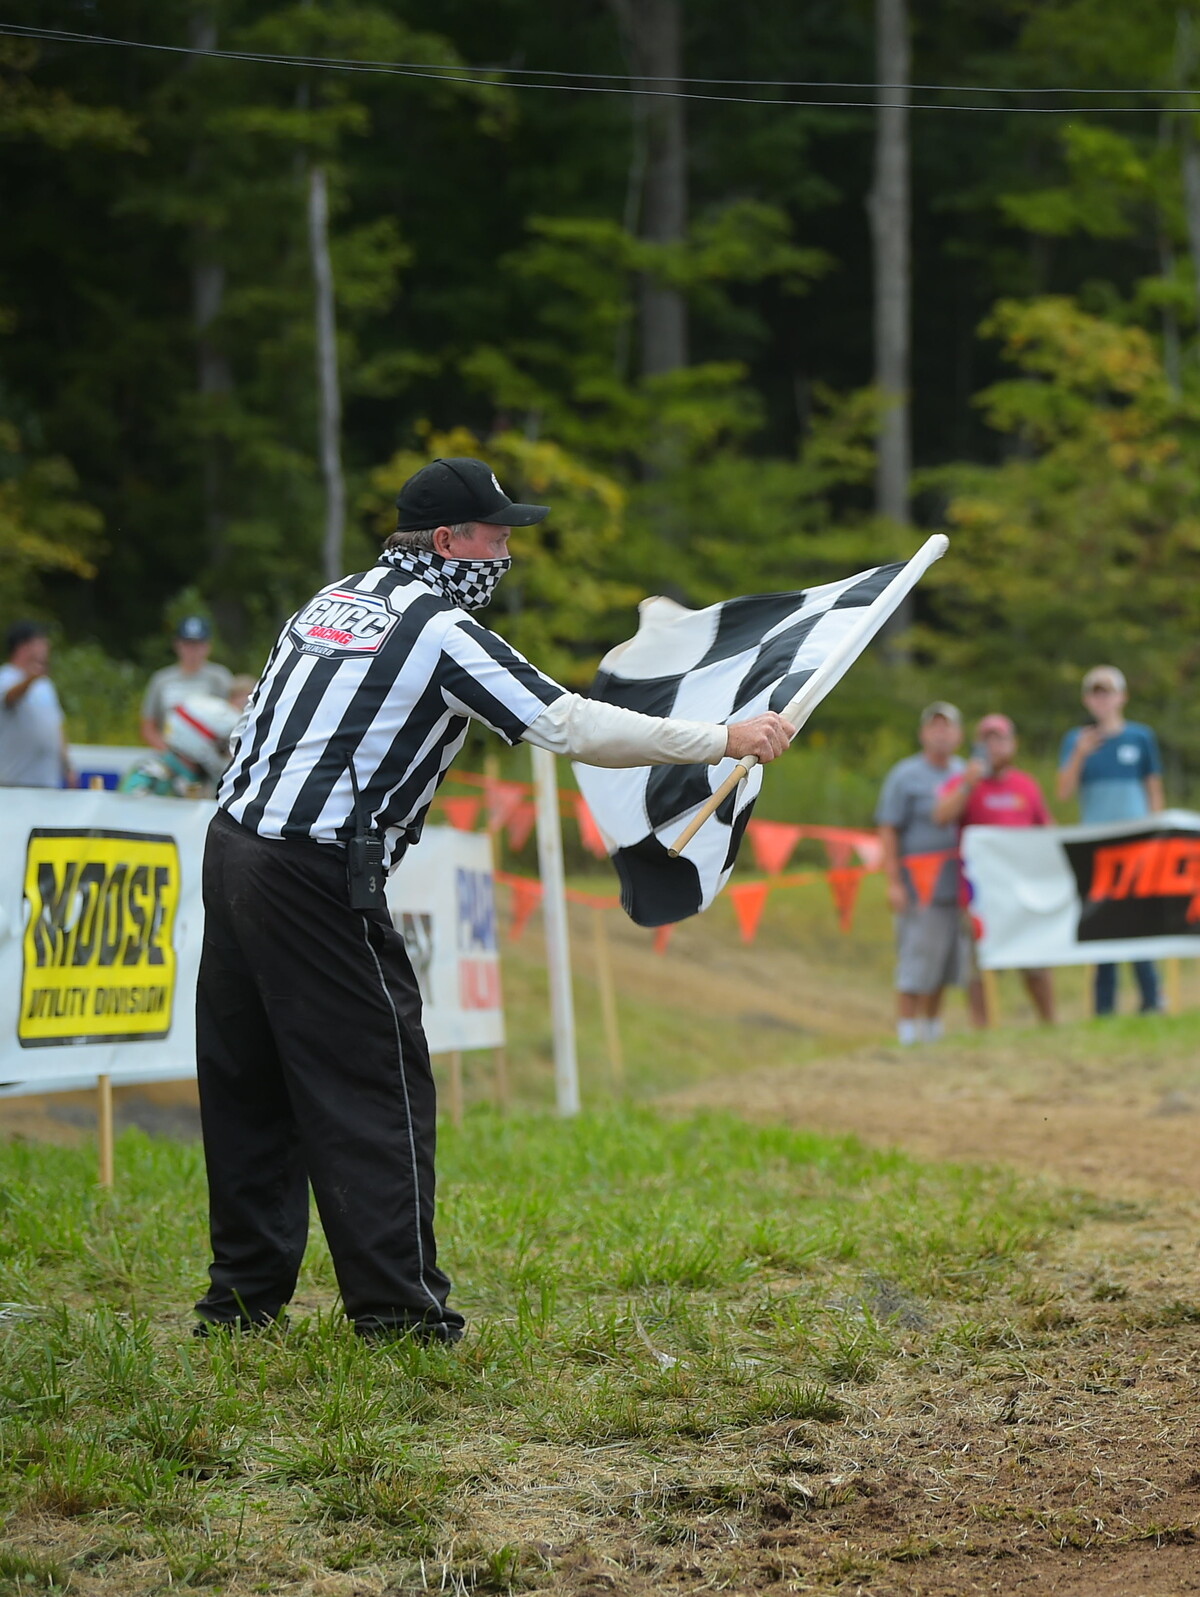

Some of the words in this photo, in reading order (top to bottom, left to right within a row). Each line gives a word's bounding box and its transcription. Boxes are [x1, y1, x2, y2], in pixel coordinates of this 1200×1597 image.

[298, 598, 391, 639] GNCC
[307, 625, 354, 645] RACING
[368, 875, 377, 893] 3
[34, 862, 170, 967] MOOSE
[28, 987, 89, 1018] UTILITY
[93, 985, 168, 1016] DIVISION
